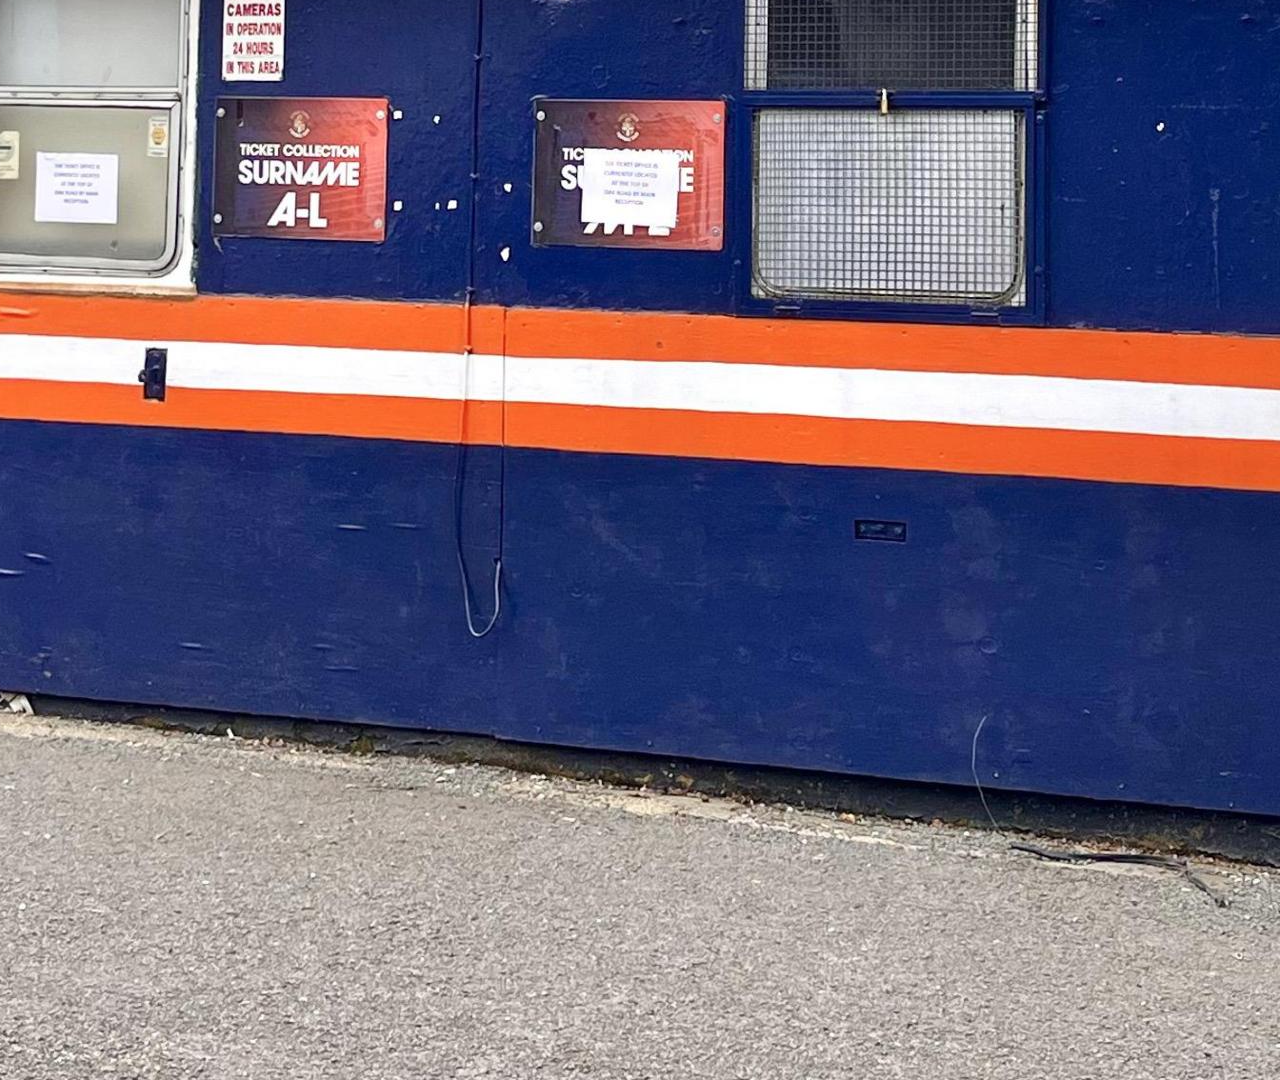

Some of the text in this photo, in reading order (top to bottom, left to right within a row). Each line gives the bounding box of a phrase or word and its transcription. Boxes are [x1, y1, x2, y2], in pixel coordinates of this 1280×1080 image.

[227, 3, 281, 16] CAMERAS
[226, 22, 281, 35] IN OPERATION
[233, 41, 274, 55] 24 HOURS
[226, 61, 280, 74] IN THIS AREA
[239, 143, 359, 158] TICKET COLLECTION
[238, 160, 360, 186] SURNAME
[267, 192, 328, 228] A-L
